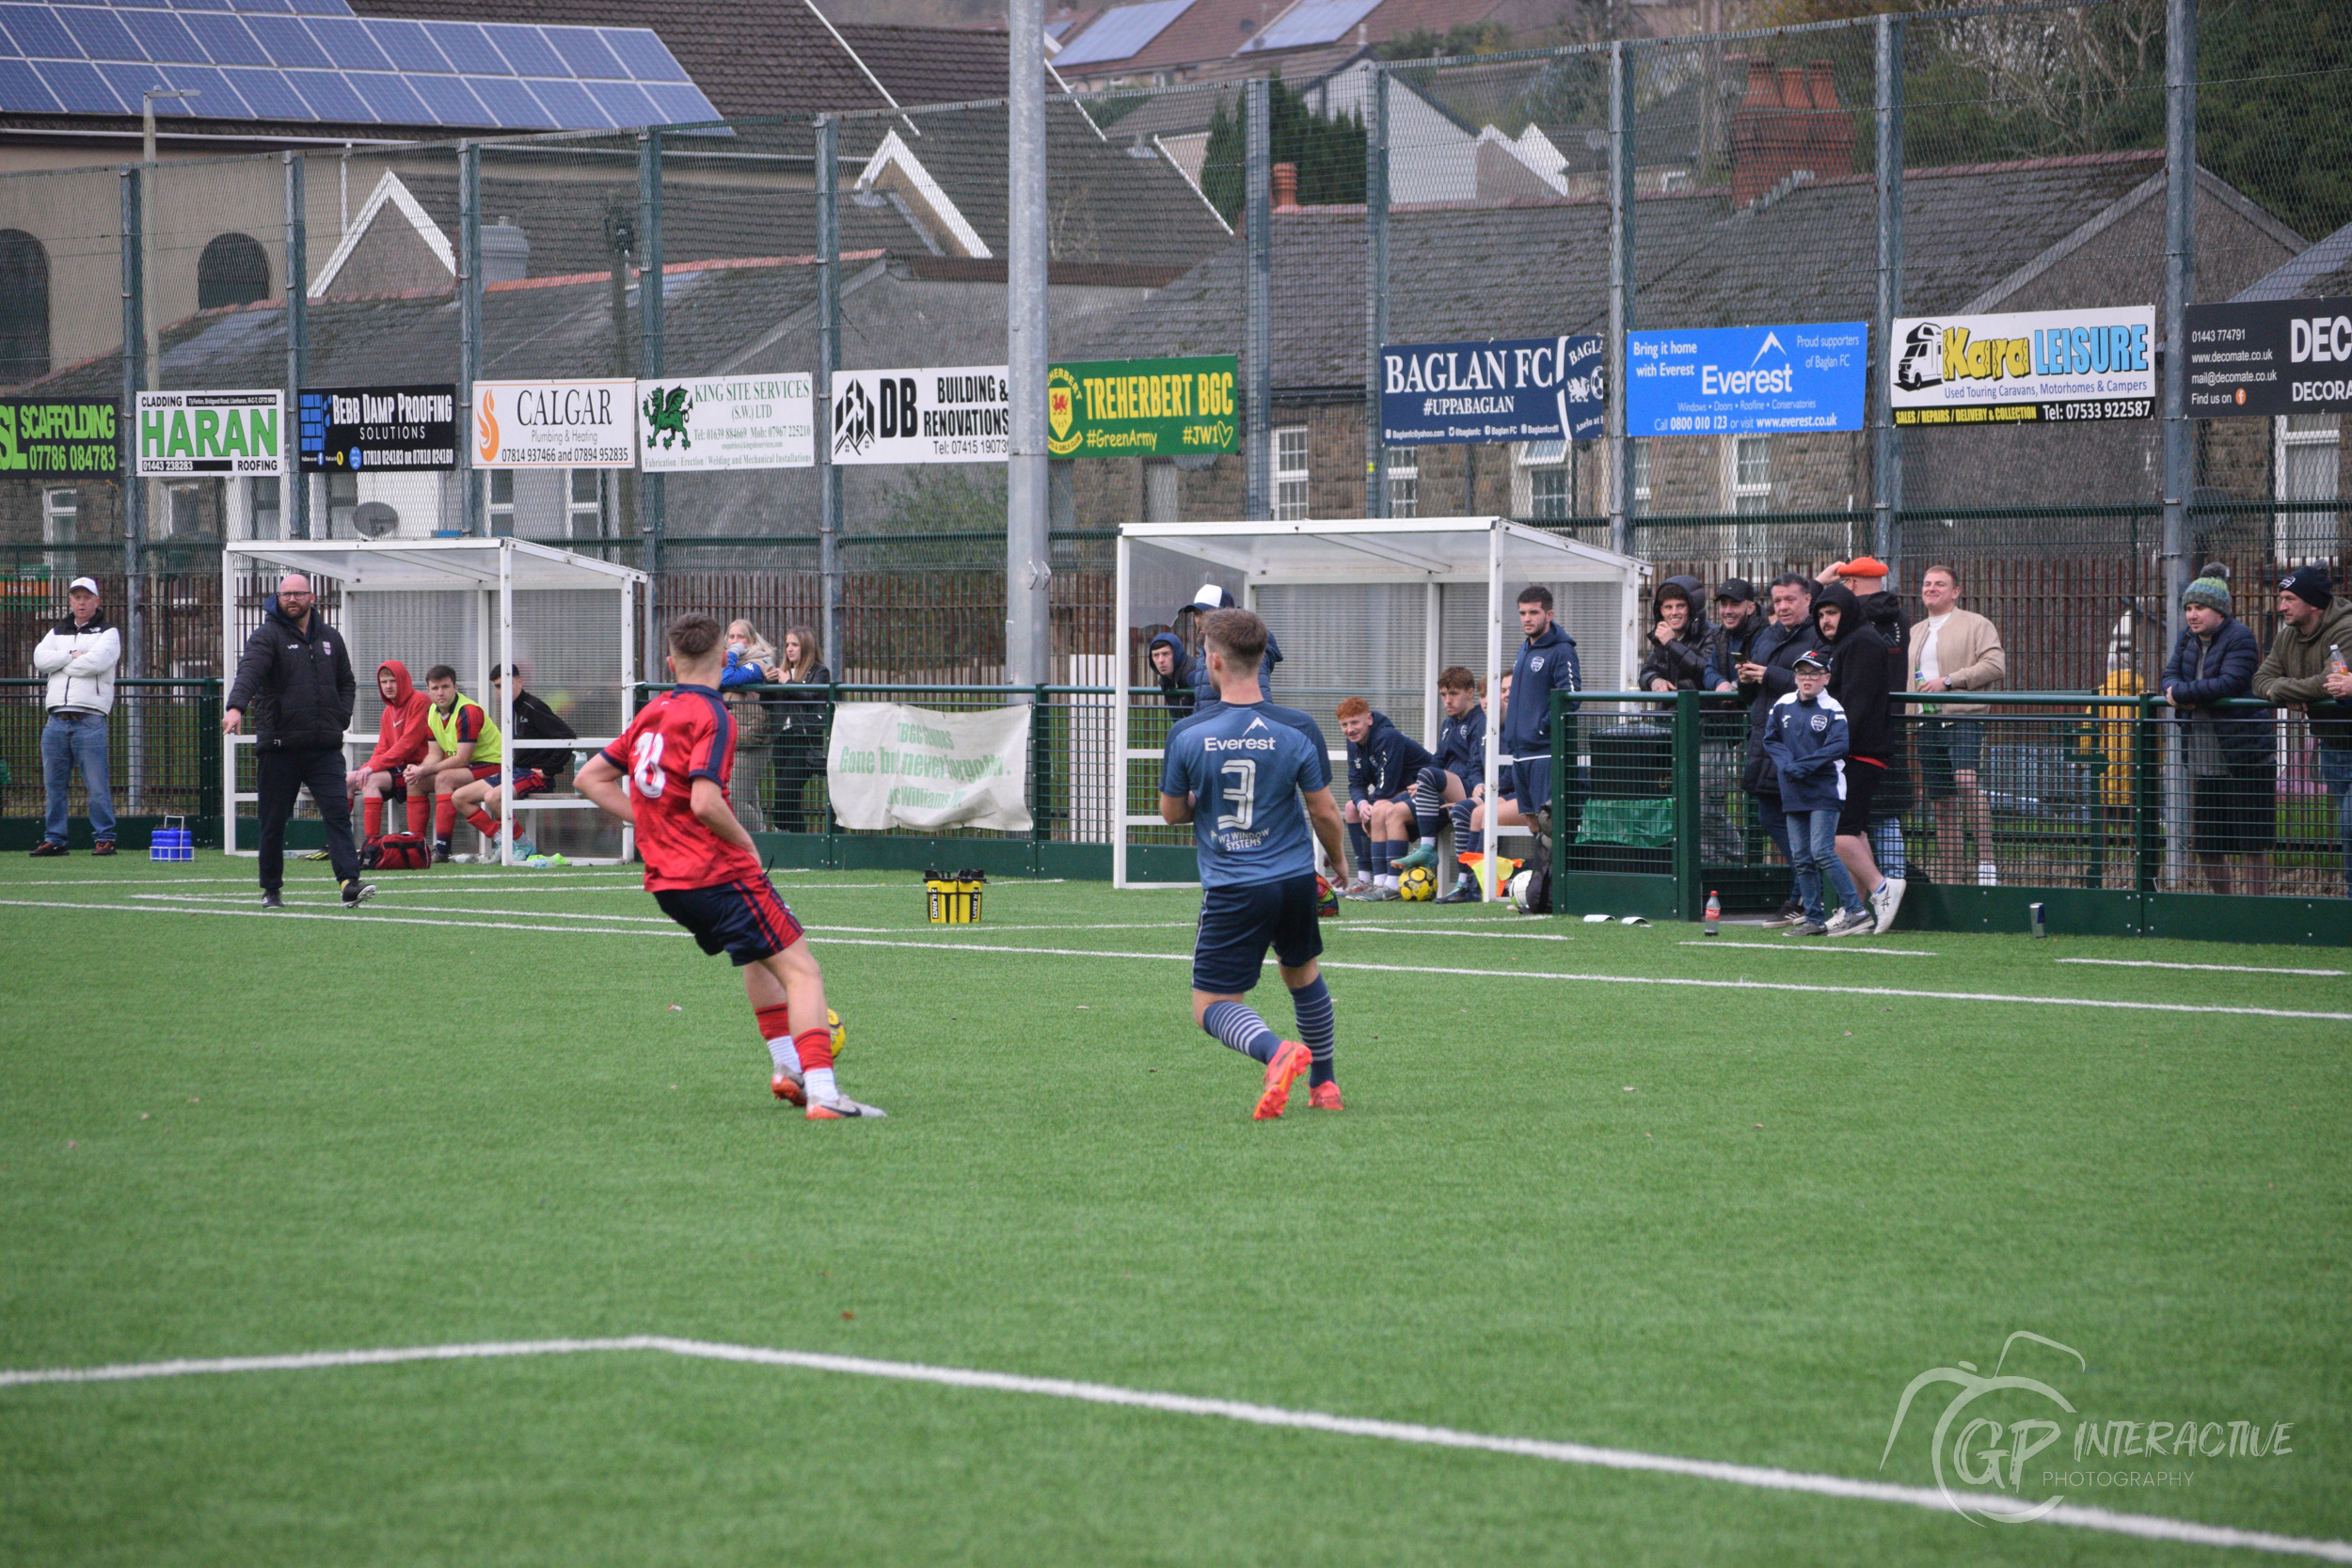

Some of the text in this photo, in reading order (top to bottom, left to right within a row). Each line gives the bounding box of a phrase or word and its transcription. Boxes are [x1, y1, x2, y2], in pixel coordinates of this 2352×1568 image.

[1797, 335, 1859, 350] Proud supporters
[2192, 329, 2246, 342] 01443 774791
[2291, 315, 2352, 363] DEC
[1633, 341, 1697, 358] Bring it home
[1943, 324, 2149, 381] Kara LEISURE
[2191, 348, 2273, 363] www.decomate.co.uk
[1385, 348, 1552, 393] BAGLAN FC
[1636, 363, 1694, 377] with Everest
[1805, 355, 1850, 372] of Baglan FC
[1702, 363, 1793, 395] Everest
[2191, 370, 2277, 386] mail@decomate.co.uk
[694, 380, 810, 403] KING SITE SERVICES
[937, 375, 1009, 404] BUILDING &
[1084, 372, 1233, 420] TREHERBERT BGC
[1945, 380, 2147, 399] Used Touring Caravans, Motorhomes & Campers
[141, 396, 183, 407] CLADDING
[517, 388, 613, 426] CALGAR
[1423, 396, 1515, 416] #UPPABAGLAN
[1677, 399, 1816, 412] Windows Doors Roofline Conservatories
[2192, 393, 2209, 404] Find
[2211, 394, 2220, 404] us
[332, 392, 453, 424] BEBB DAMP PROOFING
[732, 404, 772, 421] (S.W.) LTD
[880, 377, 918, 438] DB
[1896, 410, 1915, 423] SALES
[1921, 409, 1950, 422] REPAIRS
[1955, 408, 1987, 421] DELIVERY
[1989, 410, 1994, 421] &
[1994, 406, 2037, 420] COLLECTION
[2042, 401, 2151, 420] Tel: 07533 922587
[20, 404, 115, 439] SCAFFOLDING
[924, 408, 1009, 437] RENOVATIONS
[1654, 413, 1836, 431] Call 0800 010 123 or visit www.everest.co.uk
[141, 408, 278, 457] HARAN
[359, 425, 426, 440] SOLUTIONS
[532, 429, 598, 446] Plumbing & Heating
[693, 429, 706, 441] Tel:
[707, 428, 724, 440] 01639
[788, 425, 811, 436] 225210
[1087, 429, 1157, 451] #GreenArmy
[502, 448, 628, 462] 07814 937466 and 07894 952835
[933, 439, 1009, 454] Tel: 07415 19073
[29, 445, 116, 470] 07786 084783
[143, 461, 165, 471] 01443
[237, 460, 278, 471] ROOFING
[645, 452, 811, 467] Fabrication Erection Welding and Mechanical Installations
[1204, 737, 1277, 751] Everest
[839, 746, 875, 774] Gone
[901, 786, 950, 809] Williams
[1217, 758, 1256, 830] 3
[1231, 828, 1270, 840] WINDOW
[1226, 838, 1262, 851] SYSTEMS
